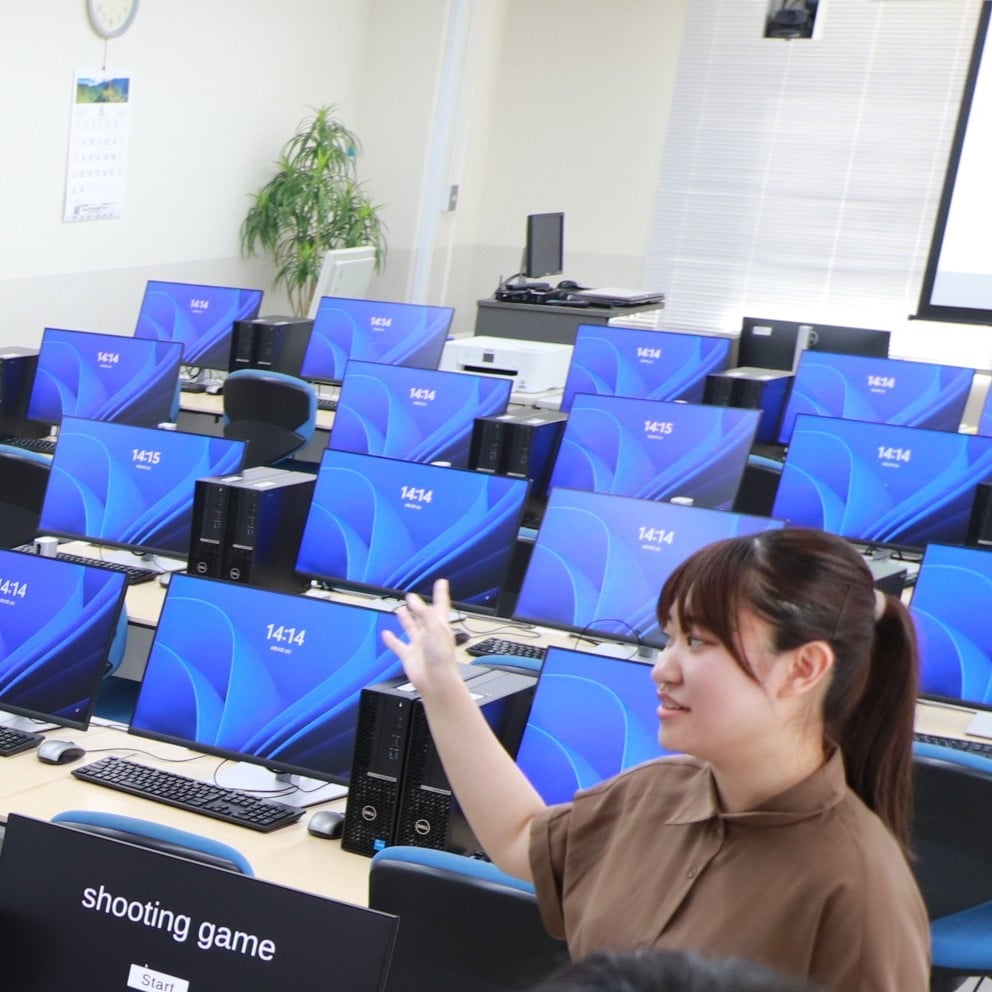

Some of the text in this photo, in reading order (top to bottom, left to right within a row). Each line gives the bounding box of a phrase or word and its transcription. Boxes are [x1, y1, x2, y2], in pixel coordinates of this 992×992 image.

[644, 420, 673, 435] 14:15
[132, 448, 161, 464] 14:15
[878, 446, 911, 462] 14:14
[401, 486, 433, 503] 14:14
[639, 526, 675, 545] 14:14
[267, 623, 306, 646] 14:14
[81, 884, 277, 962] shooting game
